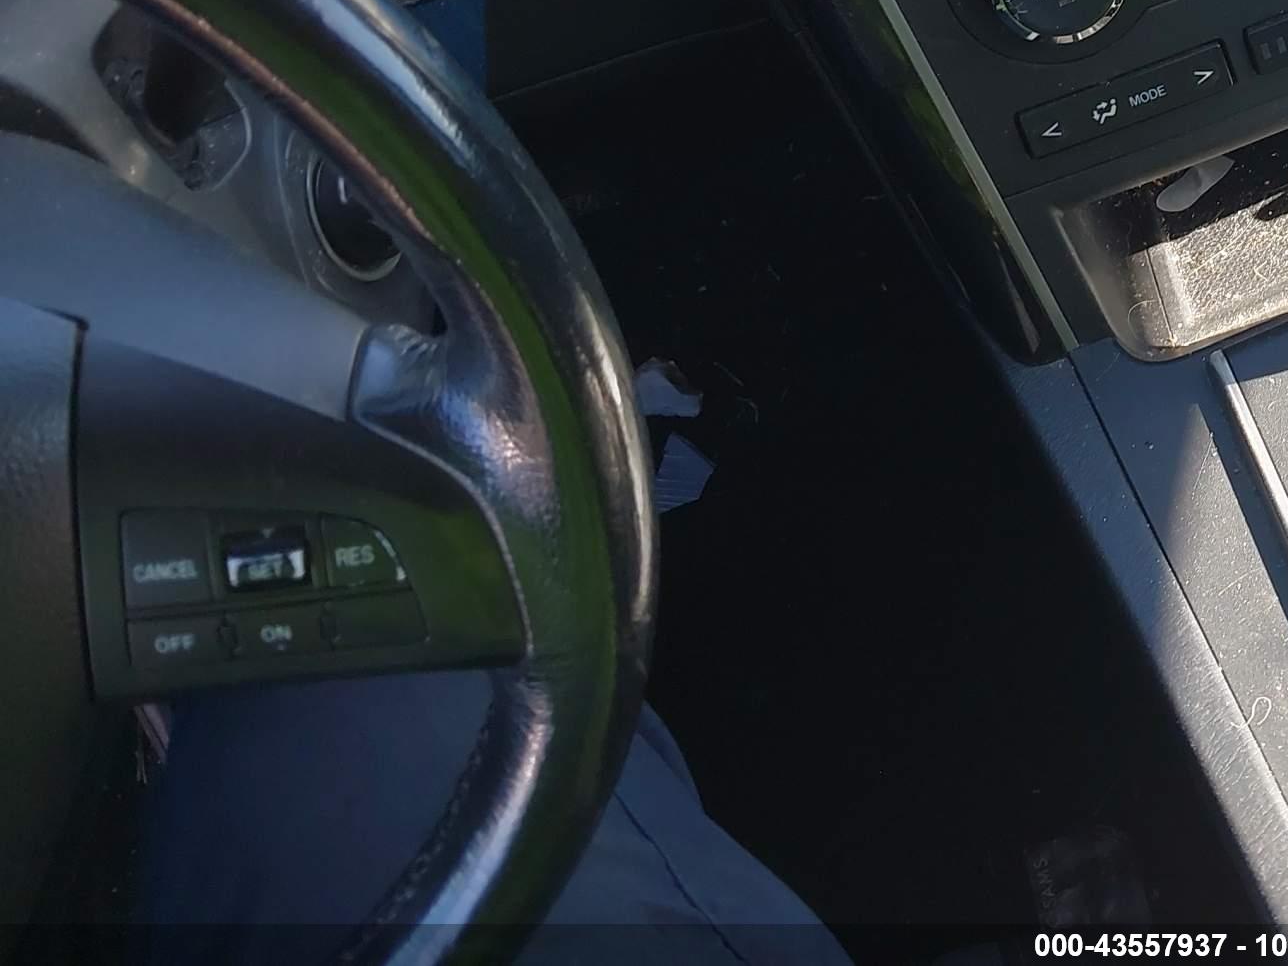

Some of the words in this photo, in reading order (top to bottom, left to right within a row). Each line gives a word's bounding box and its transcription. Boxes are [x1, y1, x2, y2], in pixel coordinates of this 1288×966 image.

[1128, 85, 1167, 107] MODE
[335, 545, 375, 567] RES
[132, 560, 198, 582] CANCEL
[154, 634, 195, 654] OFF
[260, 625, 292, 643] ON
